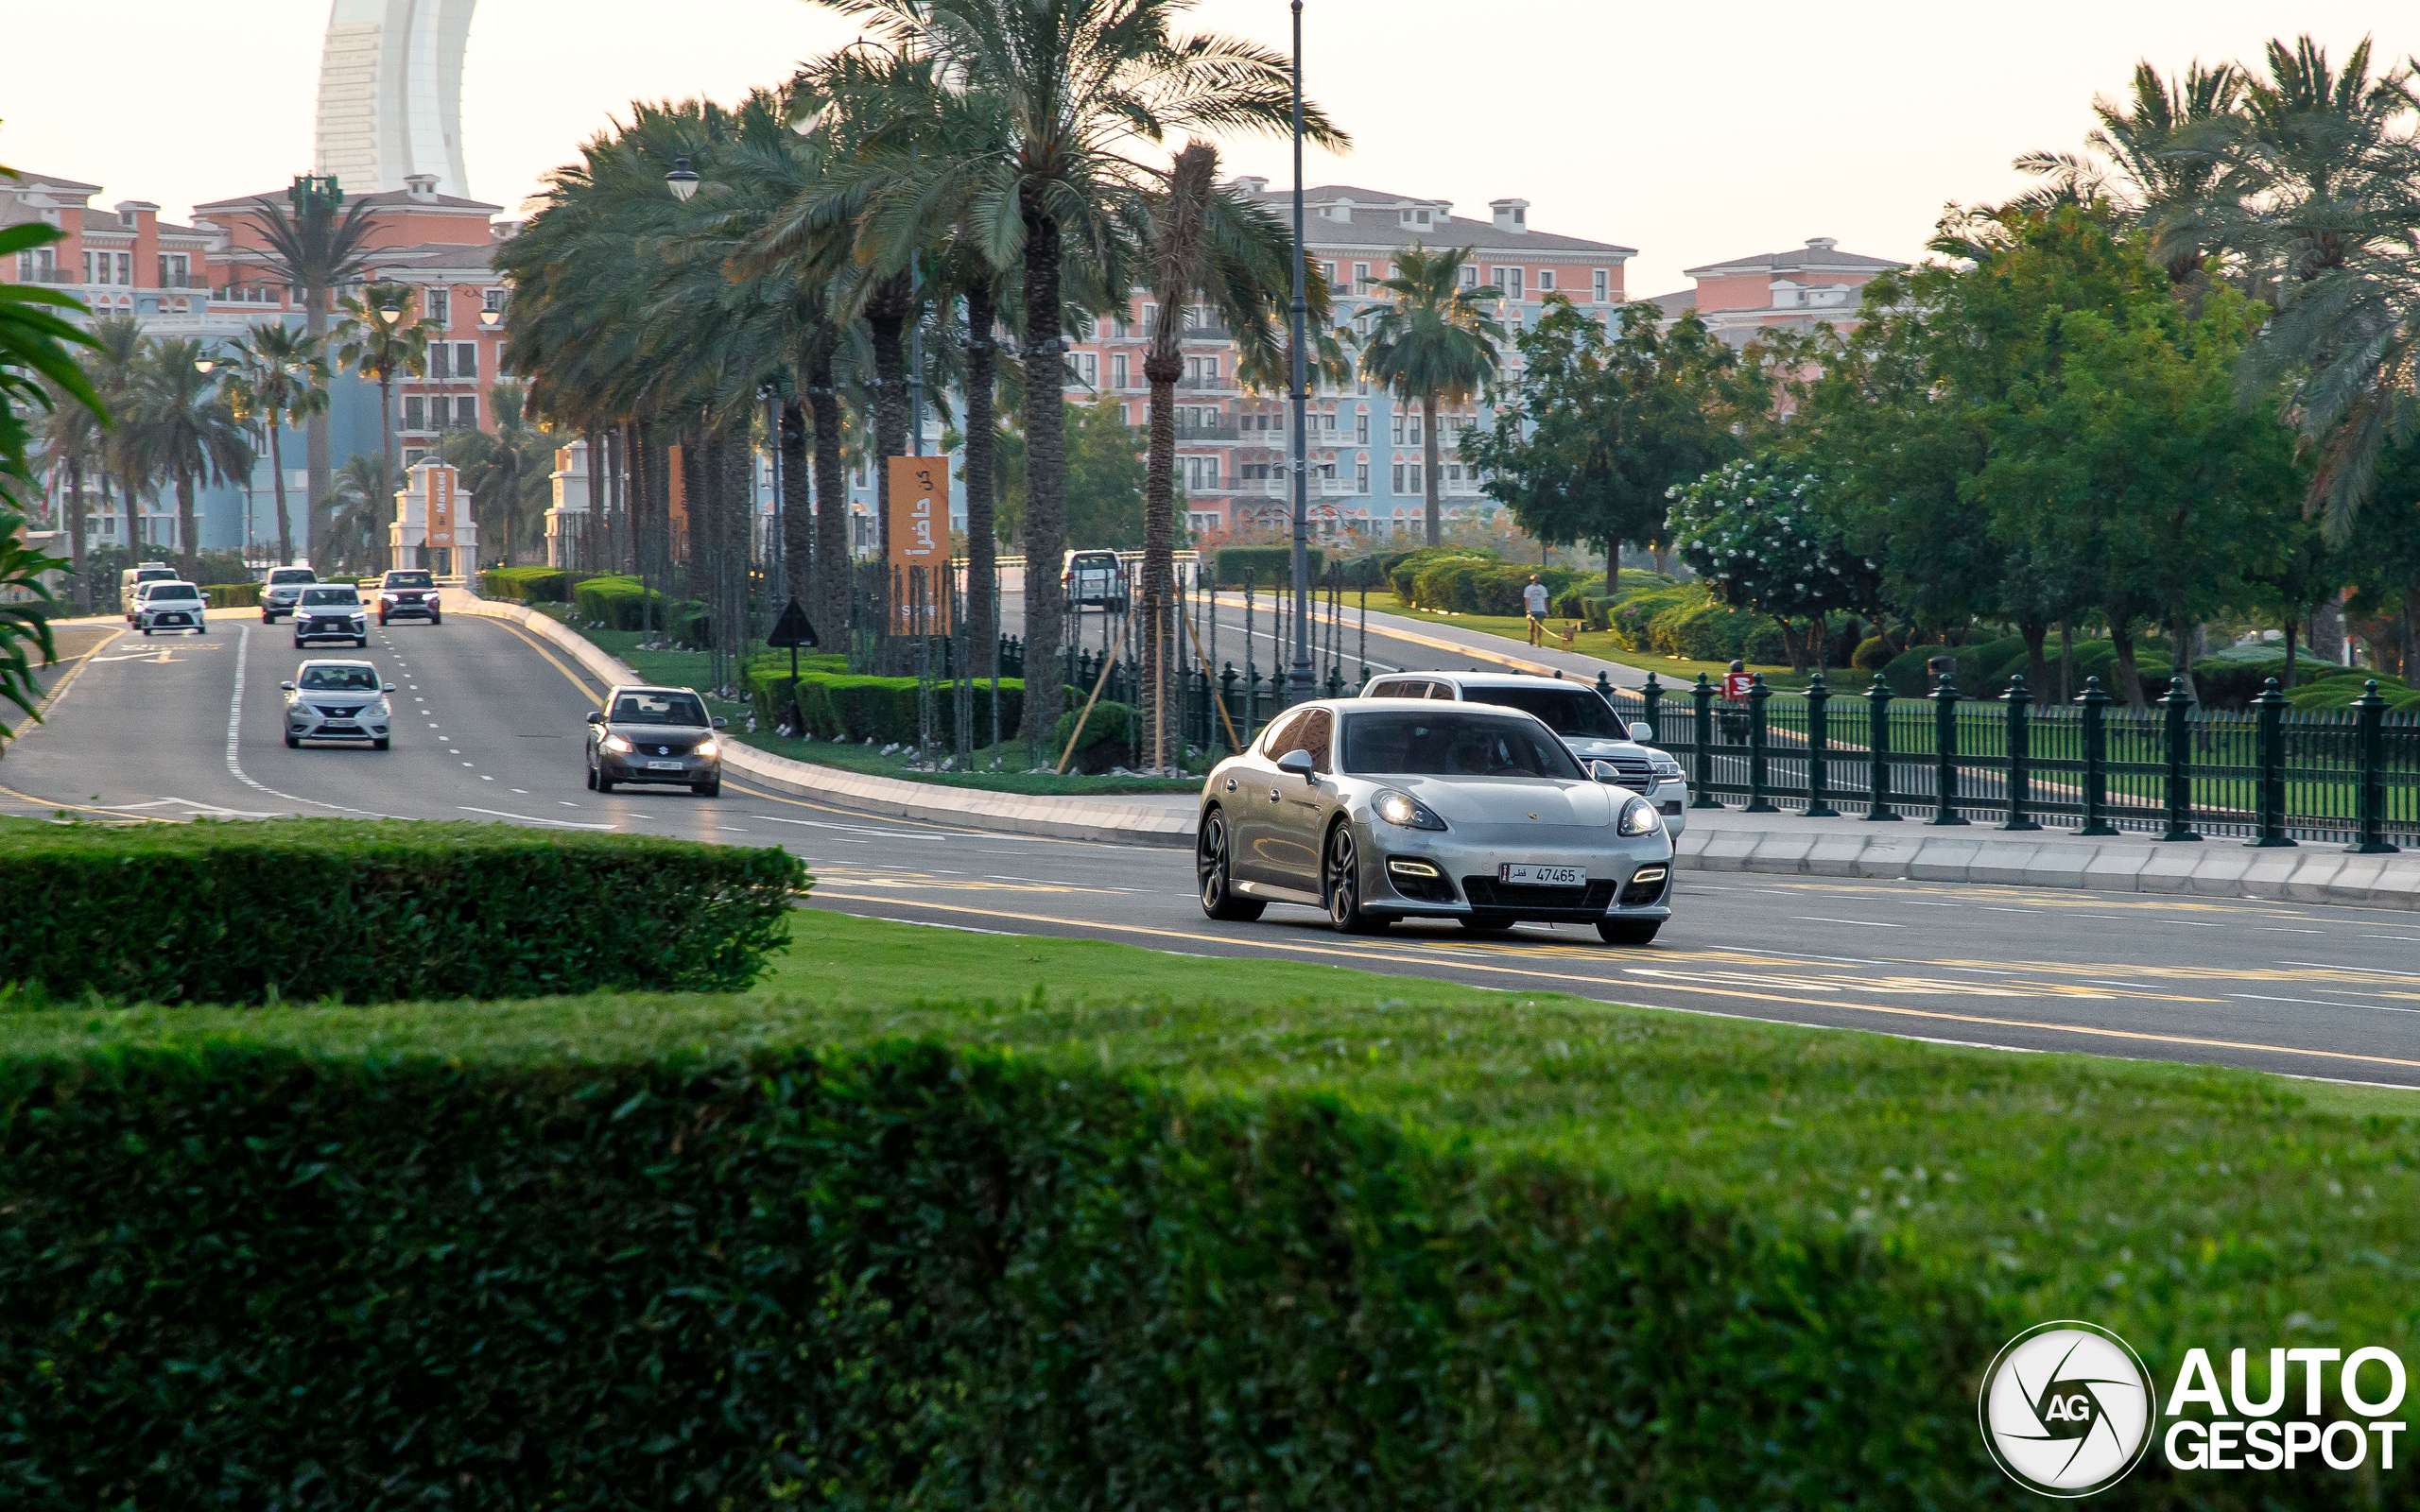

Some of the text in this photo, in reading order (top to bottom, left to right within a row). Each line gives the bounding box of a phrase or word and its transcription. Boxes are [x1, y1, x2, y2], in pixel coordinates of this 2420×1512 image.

[916, 471, 934, 490] كن
[436, 472, 447, 513] Marked
[1511, 868, 1576, 883] قطر 47465
